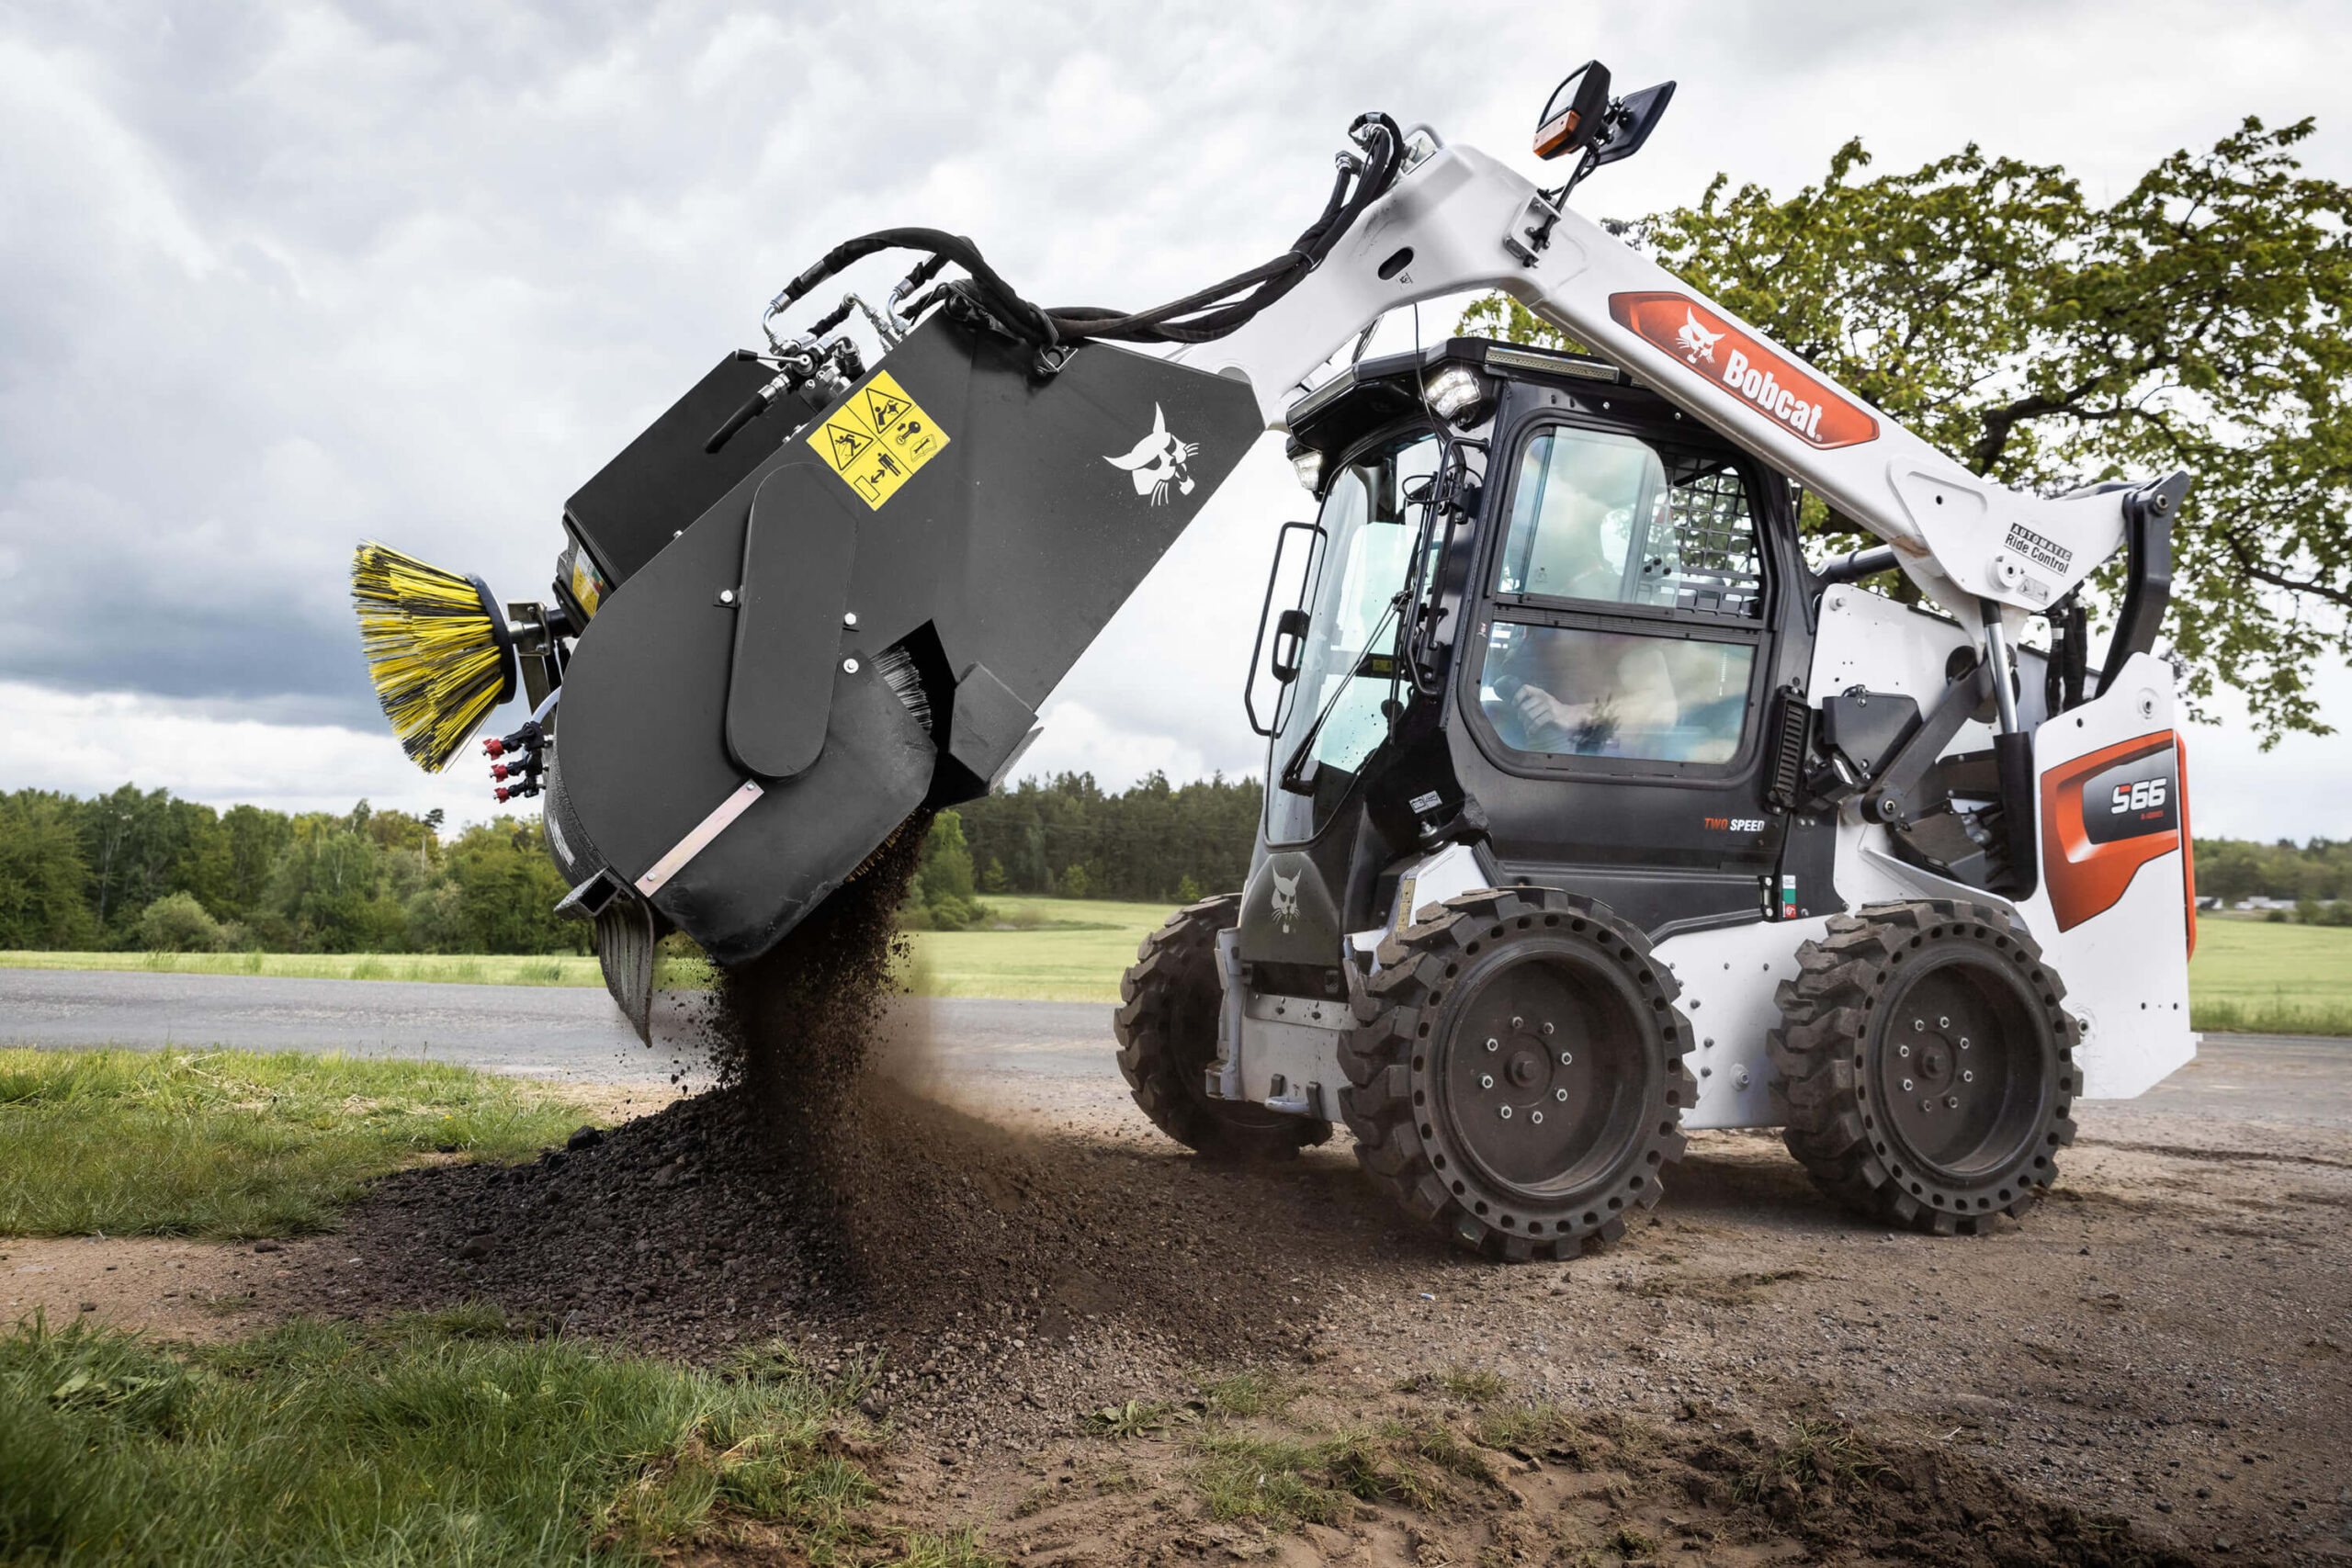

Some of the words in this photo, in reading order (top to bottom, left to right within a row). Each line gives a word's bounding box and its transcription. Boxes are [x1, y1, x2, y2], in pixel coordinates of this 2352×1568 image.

[1723, 349, 1823, 439] Bobcat
[2005, 533, 2030, 554] Ride
[2030, 546, 2069, 574] Control
[2011, 524, 2072, 561] AUTOMATIC
[2110, 777, 2168, 814] S66
[1704, 818, 1728, 830] TWO
[1730, 818, 1765, 831] SPEED
